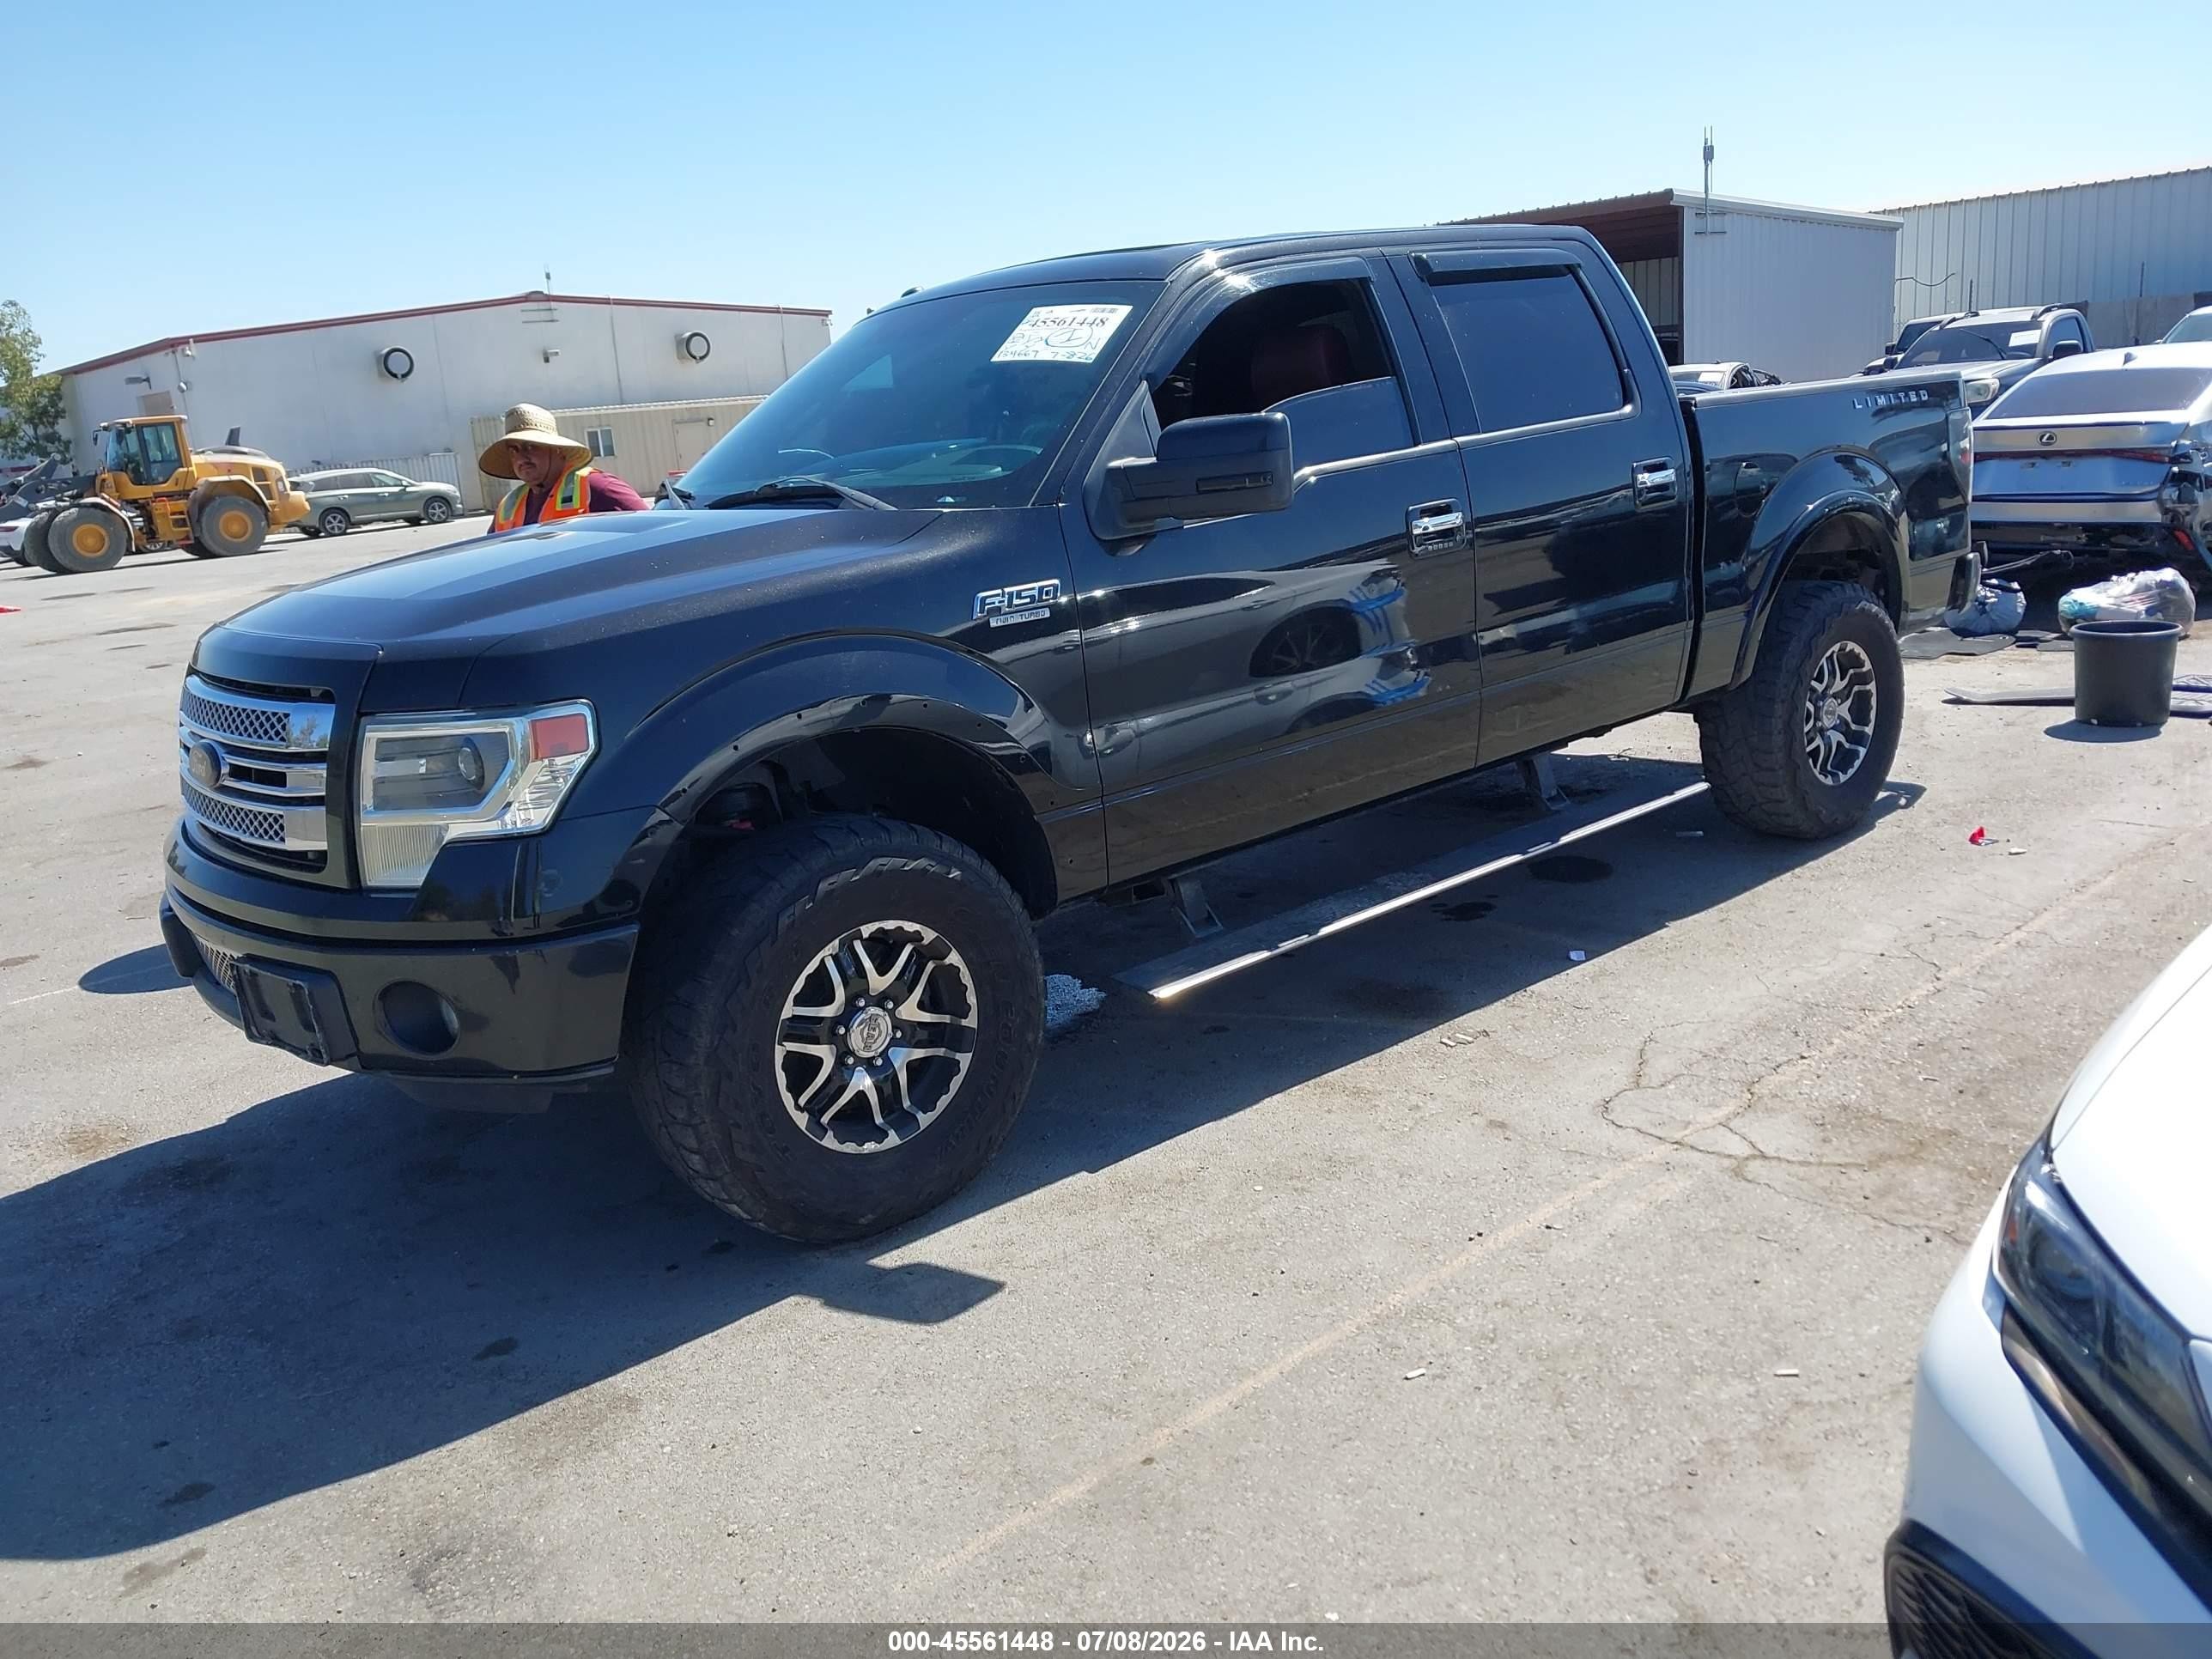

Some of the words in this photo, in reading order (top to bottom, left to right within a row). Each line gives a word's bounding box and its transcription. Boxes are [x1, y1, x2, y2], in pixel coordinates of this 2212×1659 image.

[1028, 315, 1110, 328] 45561448
[1852, 390, 1929, 410] LIMITED
[1018, 611, 1047, 621] TURBO
